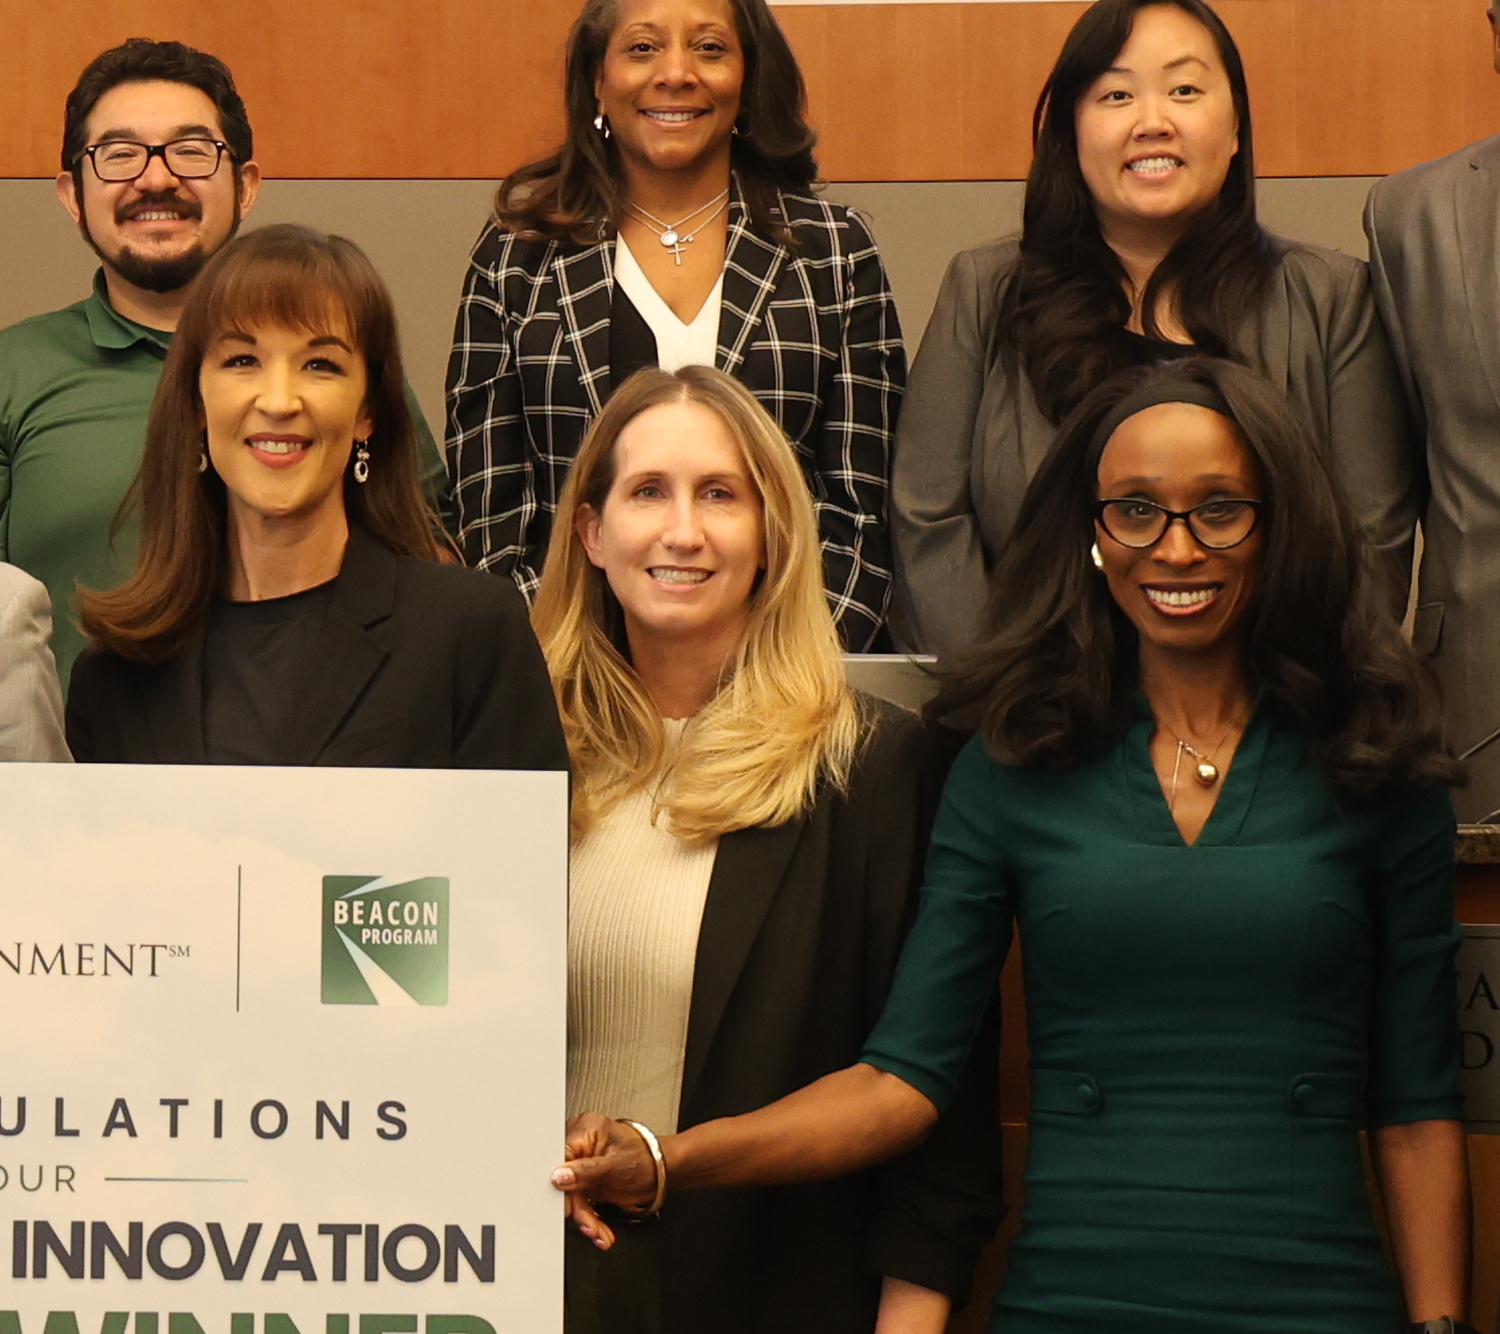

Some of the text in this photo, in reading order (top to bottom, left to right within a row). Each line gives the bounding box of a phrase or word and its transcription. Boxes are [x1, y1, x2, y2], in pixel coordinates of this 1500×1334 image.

[334, 900, 438, 926] BEACON
[362, 928, 438, 945] PROGRAM
[11, 1220, 496, 1284] INNOVATION
